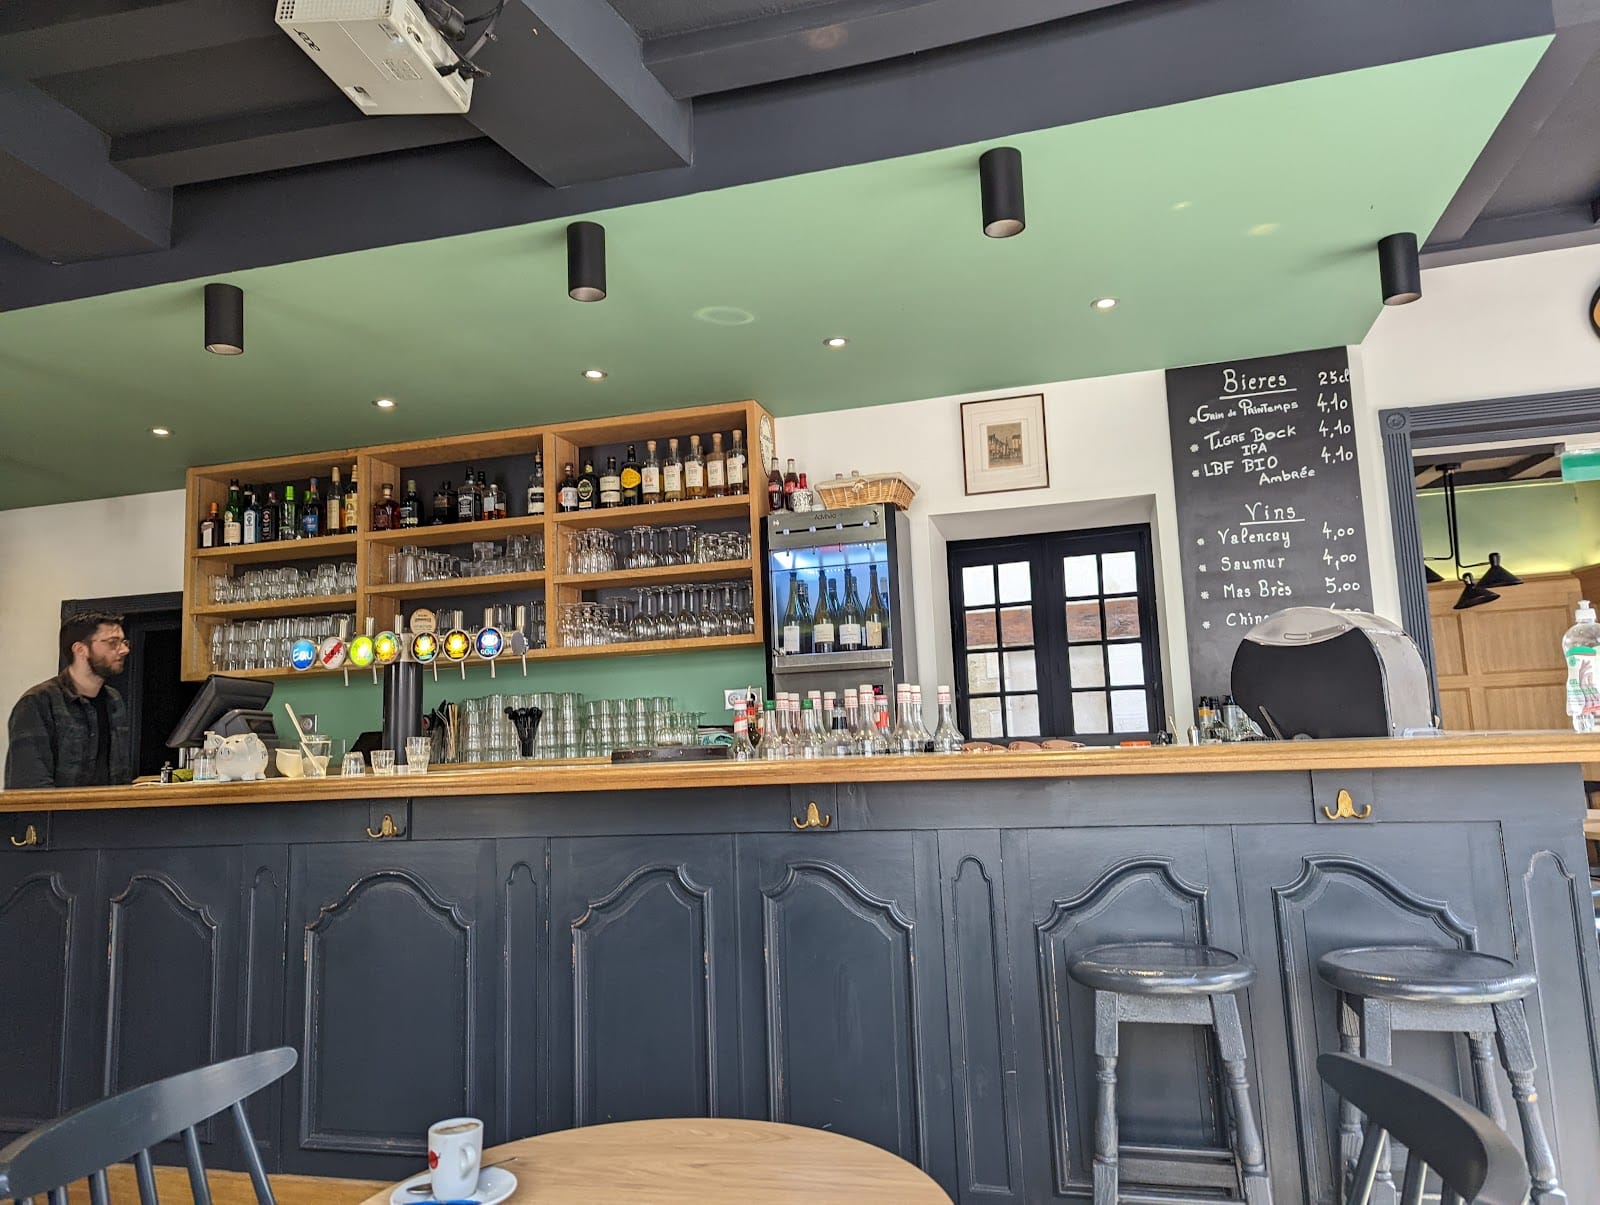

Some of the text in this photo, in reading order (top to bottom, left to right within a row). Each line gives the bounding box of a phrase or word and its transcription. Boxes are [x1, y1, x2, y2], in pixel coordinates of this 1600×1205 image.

[1223, 368, 1350, 393] Bieres 25cl
[1317, 392, 1348, 413] 4,10
[1319, 419, 1351, 439] 4,10
[1241, 442, 1267, 456] IPA
[1204, 445, 1353, 476] LBF BIO 4,10
[1244, 502, 1296, 520] Vins
[1322, 521, 1355, 541] 4,00
[1221, 548, 1357, 571] Saumur 4,00
[1223, 577, 1360, 599] Mas Brès 5,00
